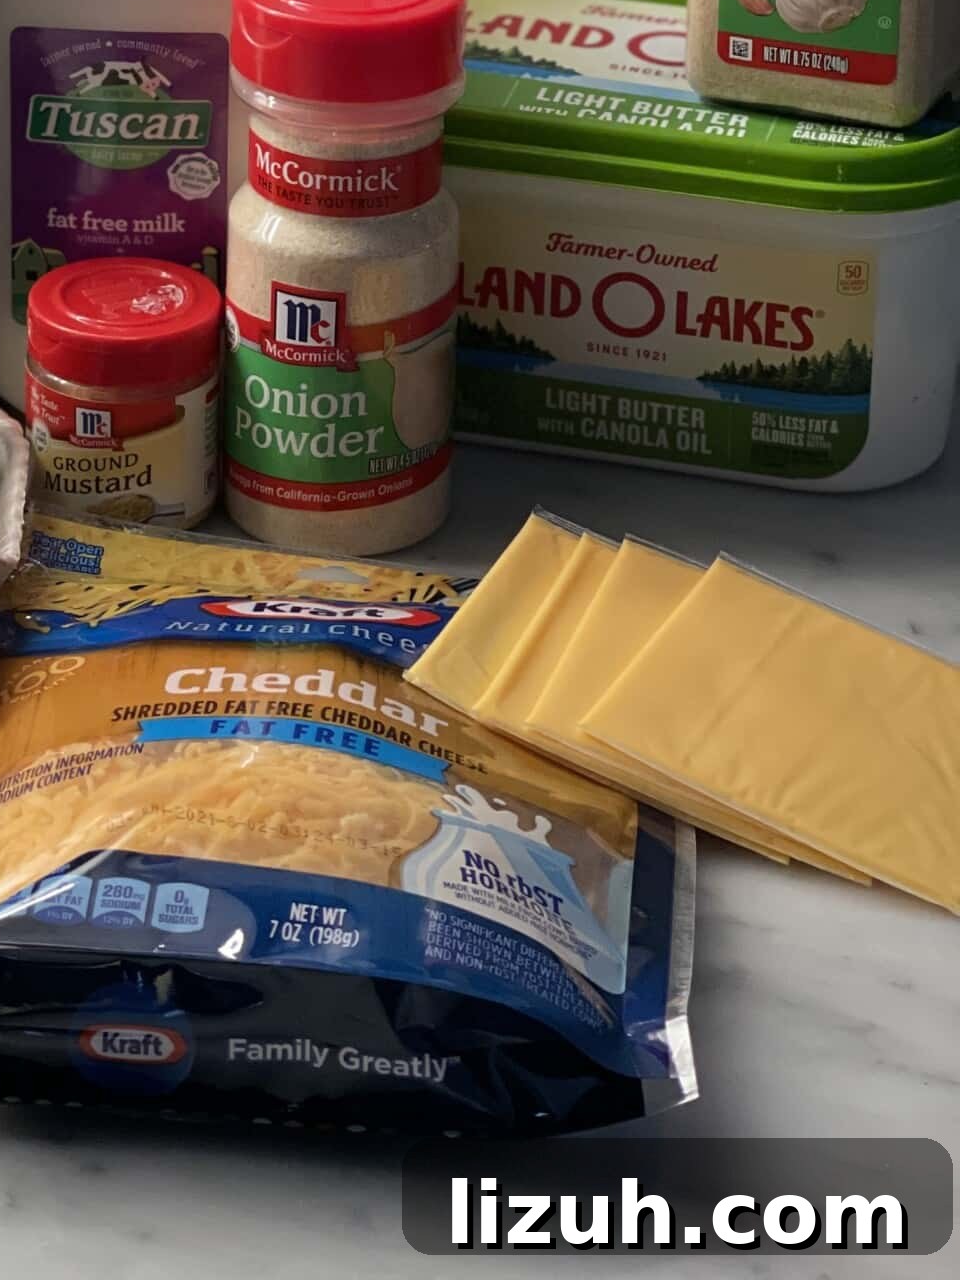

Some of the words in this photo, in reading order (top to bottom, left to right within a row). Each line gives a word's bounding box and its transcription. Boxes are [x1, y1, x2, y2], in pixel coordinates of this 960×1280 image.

[763, 45, 777, 62] NET
[778, 47, 791, 64] WT
[812, 52, 823, 68] OZ
[40, 102, 200, 140] Tuscan
[536, 87, 626, 112] LIGHT
[632, 102, 749, 127] BUTTER
[792, 129, 861, 145] CALORIES
[255, 143, 400, 192] McCormick
[257, 175, 275, 194] THE
[276, 185, 312, 206] TASTE
[315, 195, 344, 209] YOU
[348, 197, 390, 210] TRUST
[47, 208, 78, 228] fat
[82, 211, 128, 233] free
[133, 213, 186, 233] milk
[545, 232, 719, 273] Farmer-Owned
[845, 265, 862, 279] 50
[592, 271, 666, 338] O
[675, 291, 816, 352] LAKES
[264, 338, 347, 363] McCormick
[586, 342, 630, 359] SINCE
[637, 349, 668, 362] 1921
[245, 374, 368, 420] Onion
[545, 387, 613, 417] LIGHT
[617, 397, 706, 430] BUTTER
[235, 407, 385, 458] Powder
[537, 417, 576, 436] WITH
[580, 419, 670, 451] CANOLA
[676, 432, 713, 455] OIL
[752, 427, 804, 447] CALORIES
[779, 415, 806, 431] LESS
[808, 418, 828, 433] FAT
[53, 453, 139, 472] GROUND
[44, 464, 152, 495] Mustard
[253, 479, 274, 496] from
[276, 487, 375, 503] California-Grown
[378, 477, 414, 495] Onions
[66, 540, 103, 555] Open
[252, 602, 385, 618] Kraft
[165, 620, 311, 636] Natural
[329, 624, 427, 653] Chee
[165, 666, 449, 737] Cheddar
[112, 700, 218, 721] SHREDDED
[220, 700, 260, 715] FAT
[265, 701, 313, 719] FREE
[320, 706, 411, 745] CHEDDAR
[418, 740, 488, 774] CHEESE
[210, 720, 275, 737] FAT
[292, 724, 380, 757] FREE
[55, 743, 144, 772] INFORMATION
[36, 763, 94, 789] CONTENT
[463, 849, 500, 878] NO
[506, 874, 564, 916] rbST
[165, 904, 193, 915] TOTAL
[289, 902, 317, 923] NET
[321, 906, 347, 926] WT
[269, 920, 278, 938] 7
[282, 922, 301, 941] OZ
[309, 926, 360, 948] (198g)
[428, 922, 461, 938] BEEN
[465, 932, 513, 961] SHOWN
[450, 913, 519, 951] SIGNIFICANT
[424, 945, 452, 963] AND
[425, 933, 481, 957] DERIVED
[485, 950, 520, 973] FROM
[101, 1032, 164, 1057] Kraft
[228, 1039, 329, 1068] Family
[339, 1046, 450, 1081] Greatly
